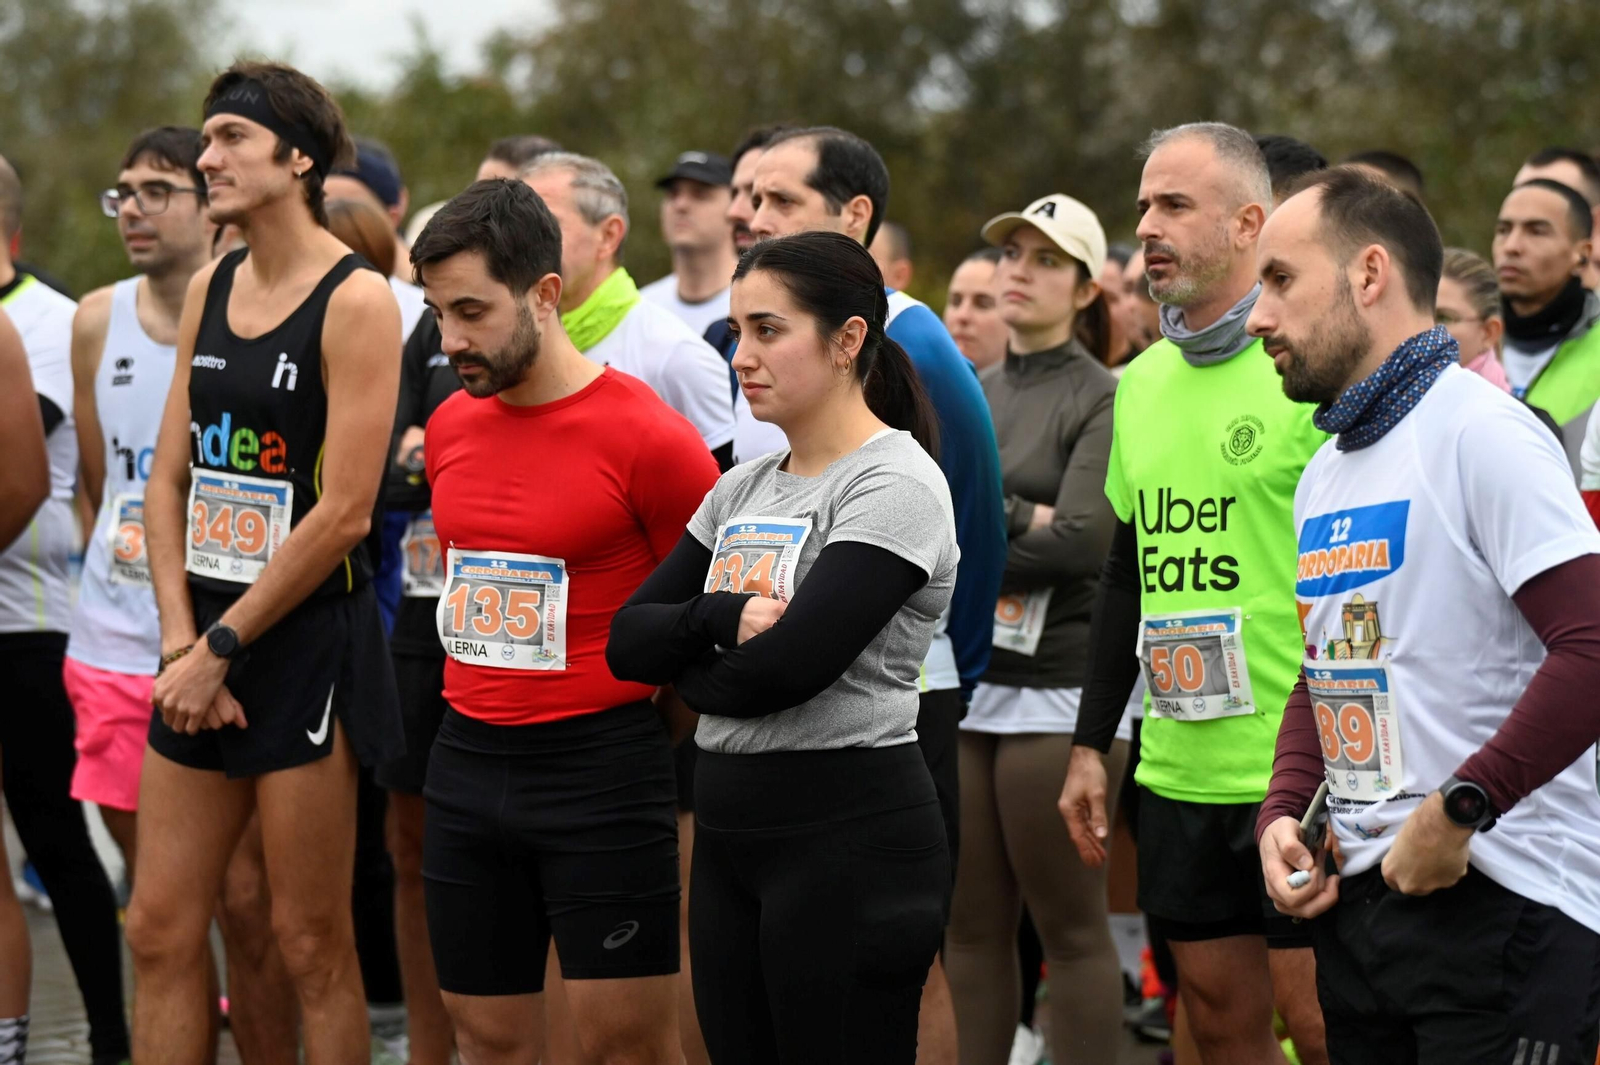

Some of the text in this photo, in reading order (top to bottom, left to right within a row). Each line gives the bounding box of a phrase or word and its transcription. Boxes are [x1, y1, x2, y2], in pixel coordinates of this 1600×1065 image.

[1032, 202, 1056, 219] A
[271, 352, 298, 391] in
[190, 411, 286, 473] ndea
[192, 500, 268, 555] 349
[739, 525, 757, 533] 12
[1138, 487, 1236, 535] Uber
[1329, 517, 1352, 543] 12
[461, 566, 553, 580] CORDOBARIA
[490, 560, 508, 568] 12
[709, 552, 777, 598] 234
[1142, 546, 1240, 593] Eats
[446, 583, 540, 639] 135
[546, 603, 556, 631] NAVIDAD
[1166, 620, 1183, 628] 12
[1151, 645, 1204, 693] 50
[1314, 671, 1332, 679] 12
[1316, 702, 1375, 764] 89
